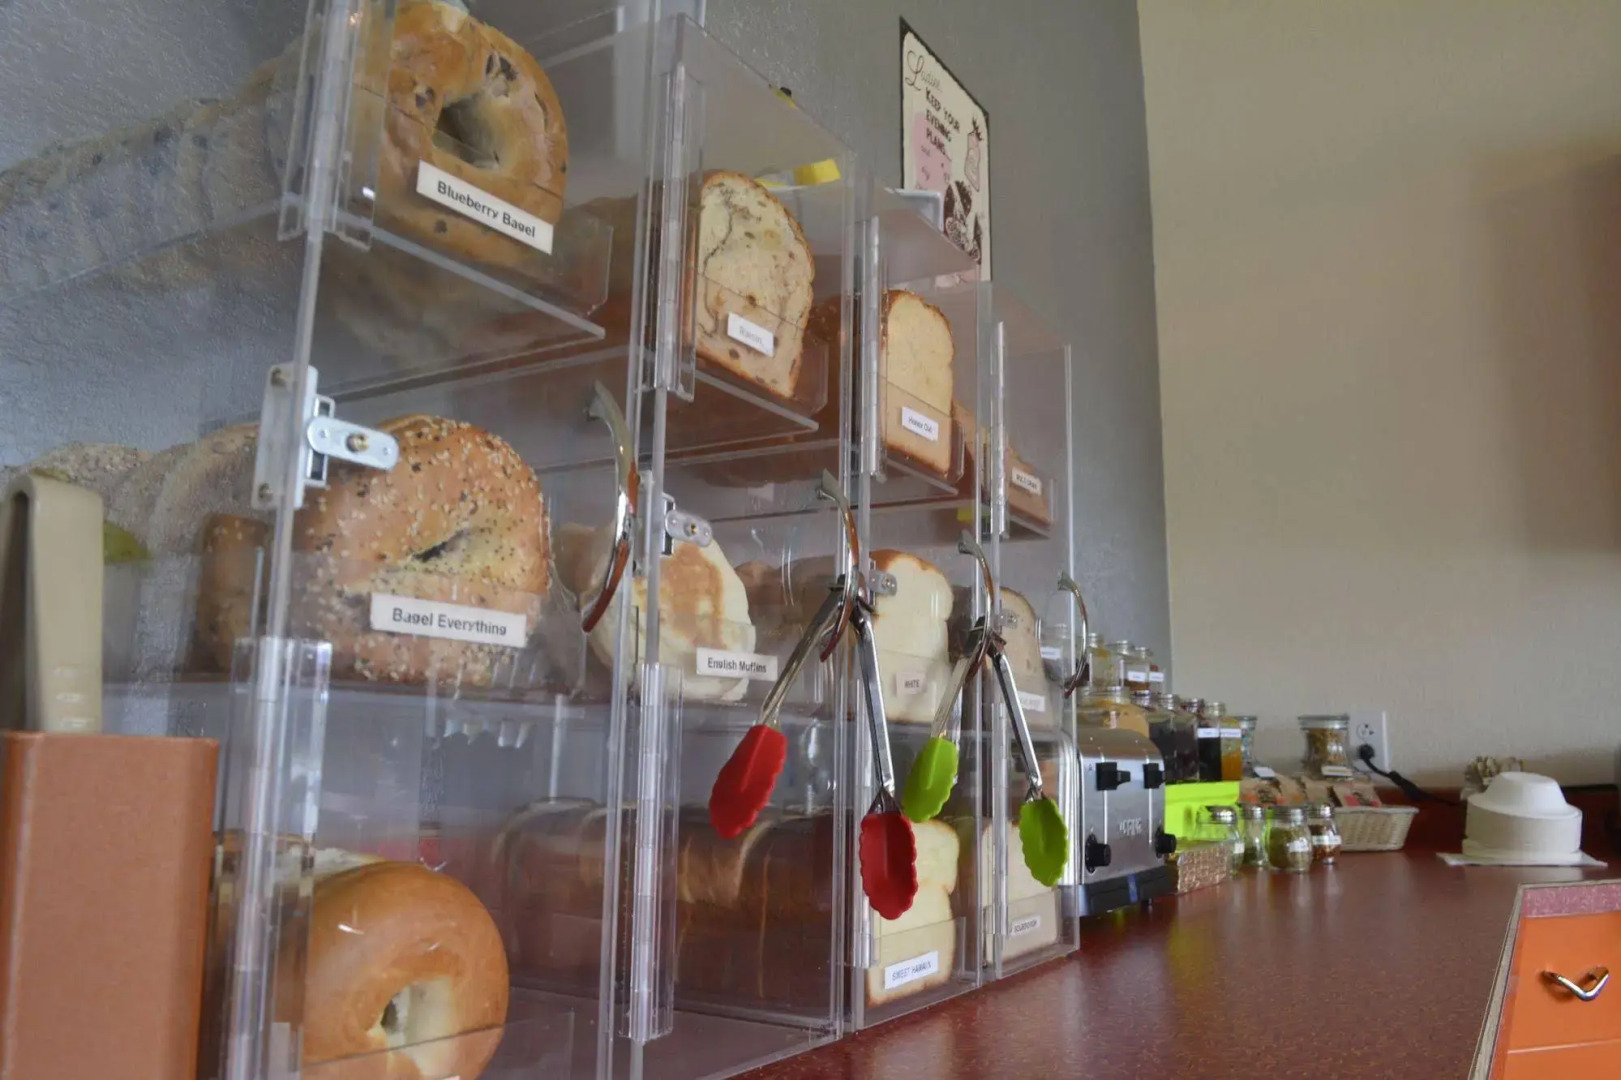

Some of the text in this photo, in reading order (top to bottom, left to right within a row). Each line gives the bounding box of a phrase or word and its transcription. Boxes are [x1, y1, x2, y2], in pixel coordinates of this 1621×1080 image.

[437, 180, 536, 238] Blueberry Bagel
[392, 607, 507, 636] Bagel Everything
[707, 657, 767, 673] English Muffins
[892, 967, 910, 981] SWEET
